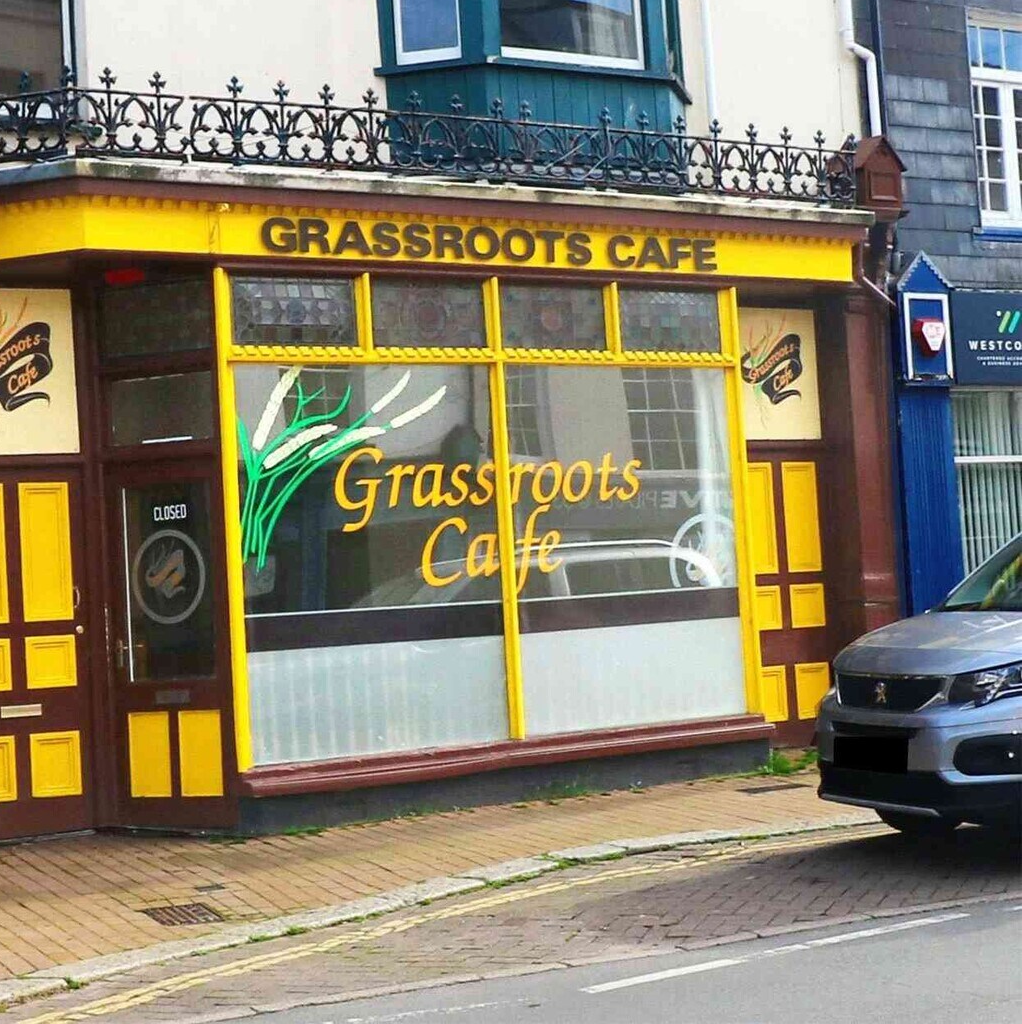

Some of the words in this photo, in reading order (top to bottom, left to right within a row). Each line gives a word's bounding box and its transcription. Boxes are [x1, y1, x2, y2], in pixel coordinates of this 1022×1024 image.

[261, 216, 593, 266] GRASSROOTS
[607, 234, 718, 272] CAFE
[7, 361, 38, 394] Cafe
[153, 503, 187, 521] CLOSED
[334, 446, 642, 533] Grassroots
[421, 503, 564, 594] Cafe
